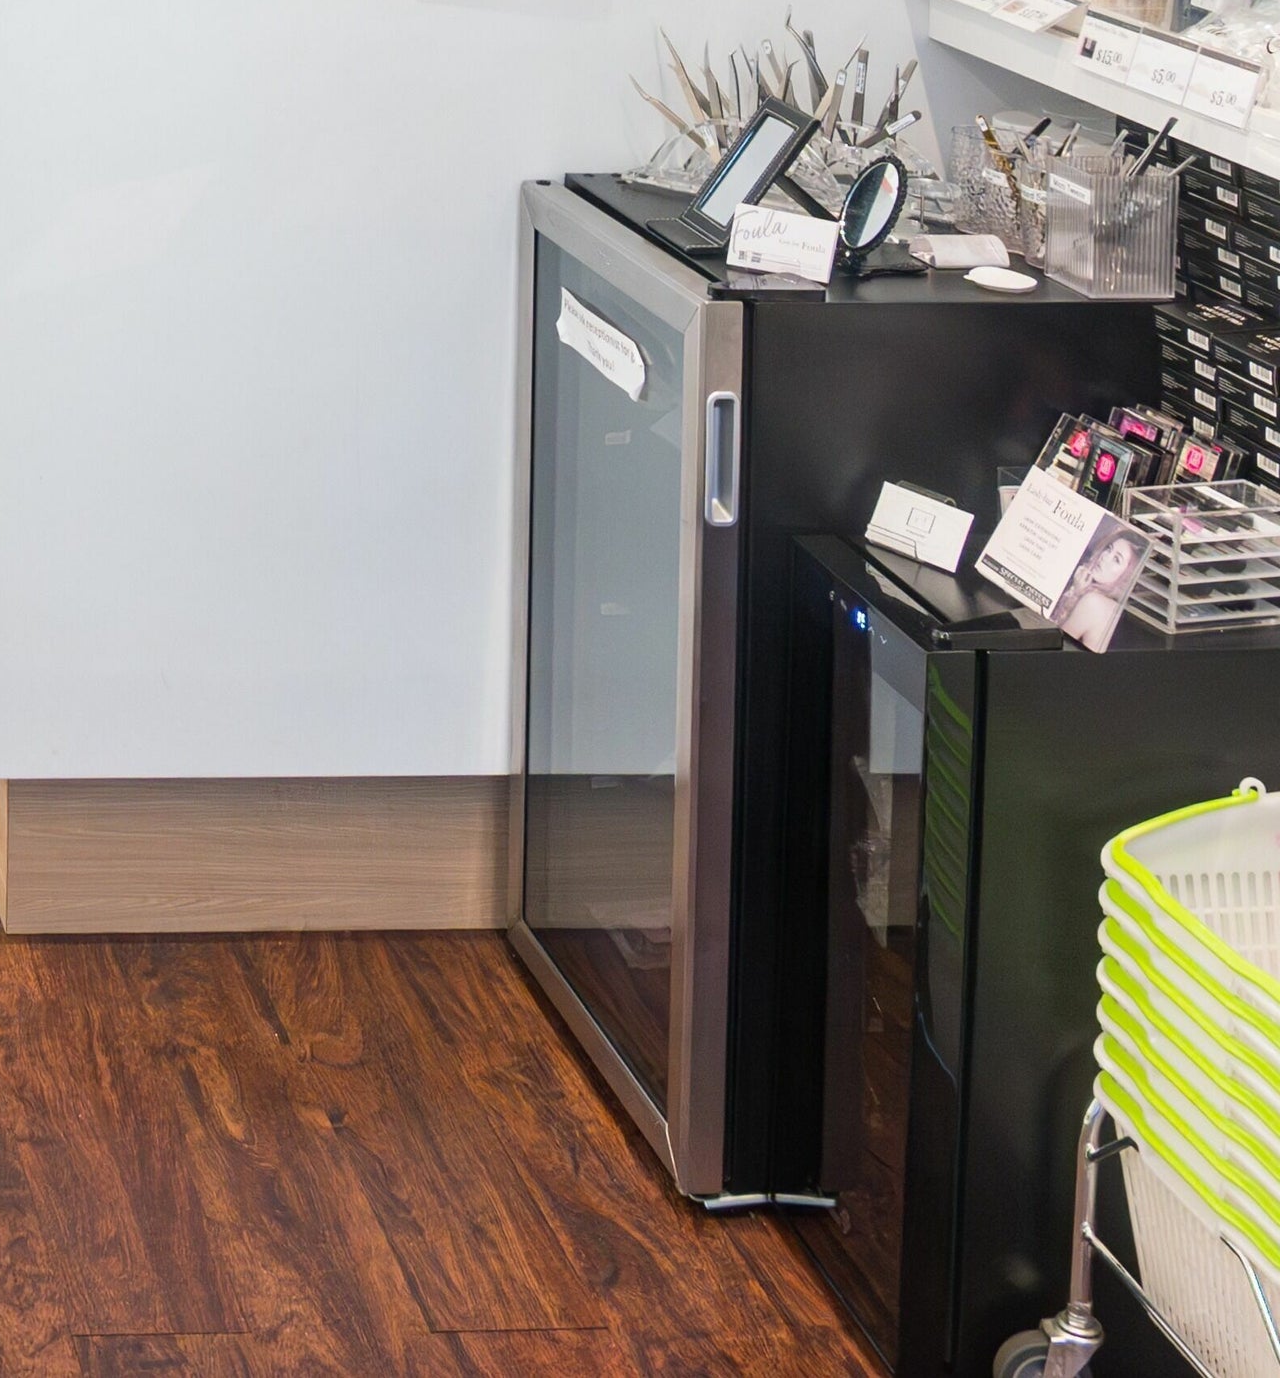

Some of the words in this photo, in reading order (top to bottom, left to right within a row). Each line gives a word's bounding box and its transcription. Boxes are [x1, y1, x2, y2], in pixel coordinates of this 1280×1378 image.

[1096, 48, 1123, 66] $15.00
[1152, 68, 1176, 85] $5.00
[1210, 90, 1238, 108] $5.00
[733, 210, 788, 254] Foula
[1053, 499, 1087, 532] Foula
[1000, 566, 1025, 586] SPECIAL
